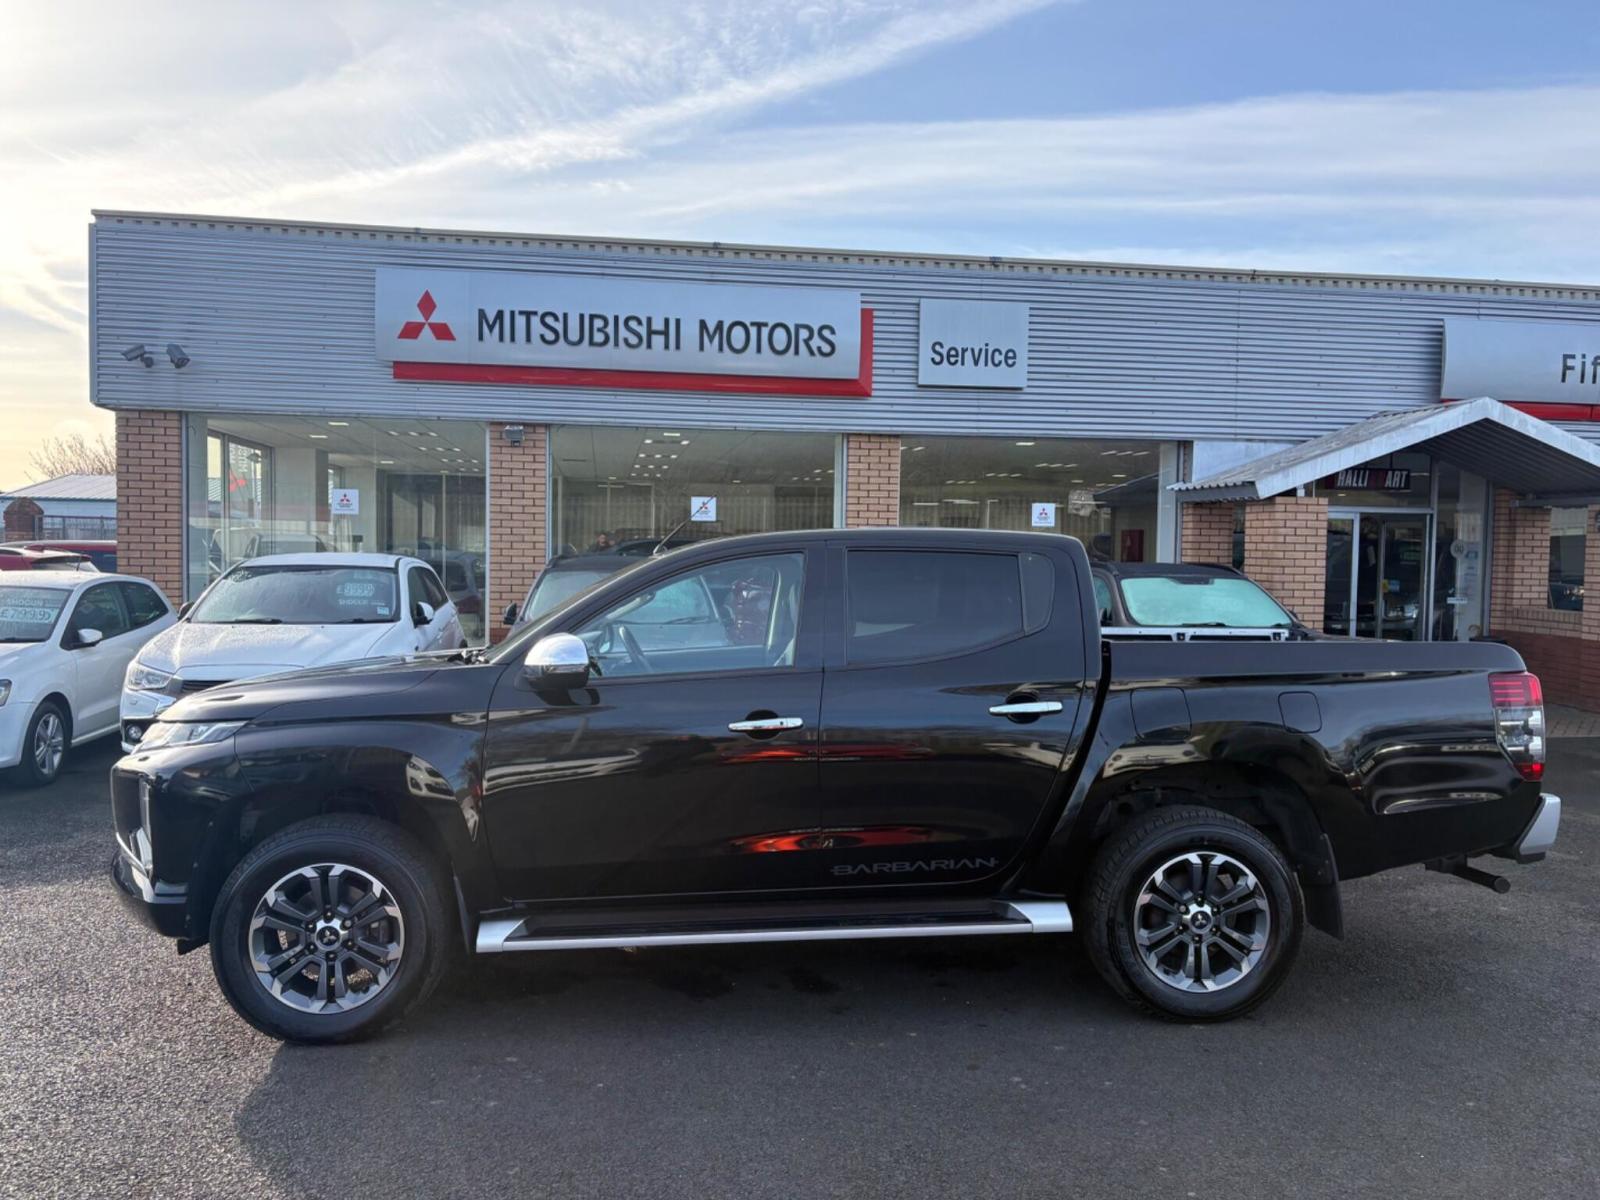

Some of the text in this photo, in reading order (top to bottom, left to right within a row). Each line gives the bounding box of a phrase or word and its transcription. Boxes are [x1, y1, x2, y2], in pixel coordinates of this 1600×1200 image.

[477, 307, 837, 358] MITSUBISHI MOTORS
[930, 341, 1017, 368] Service
[830, 856, 999, 876] BARBARIAN
